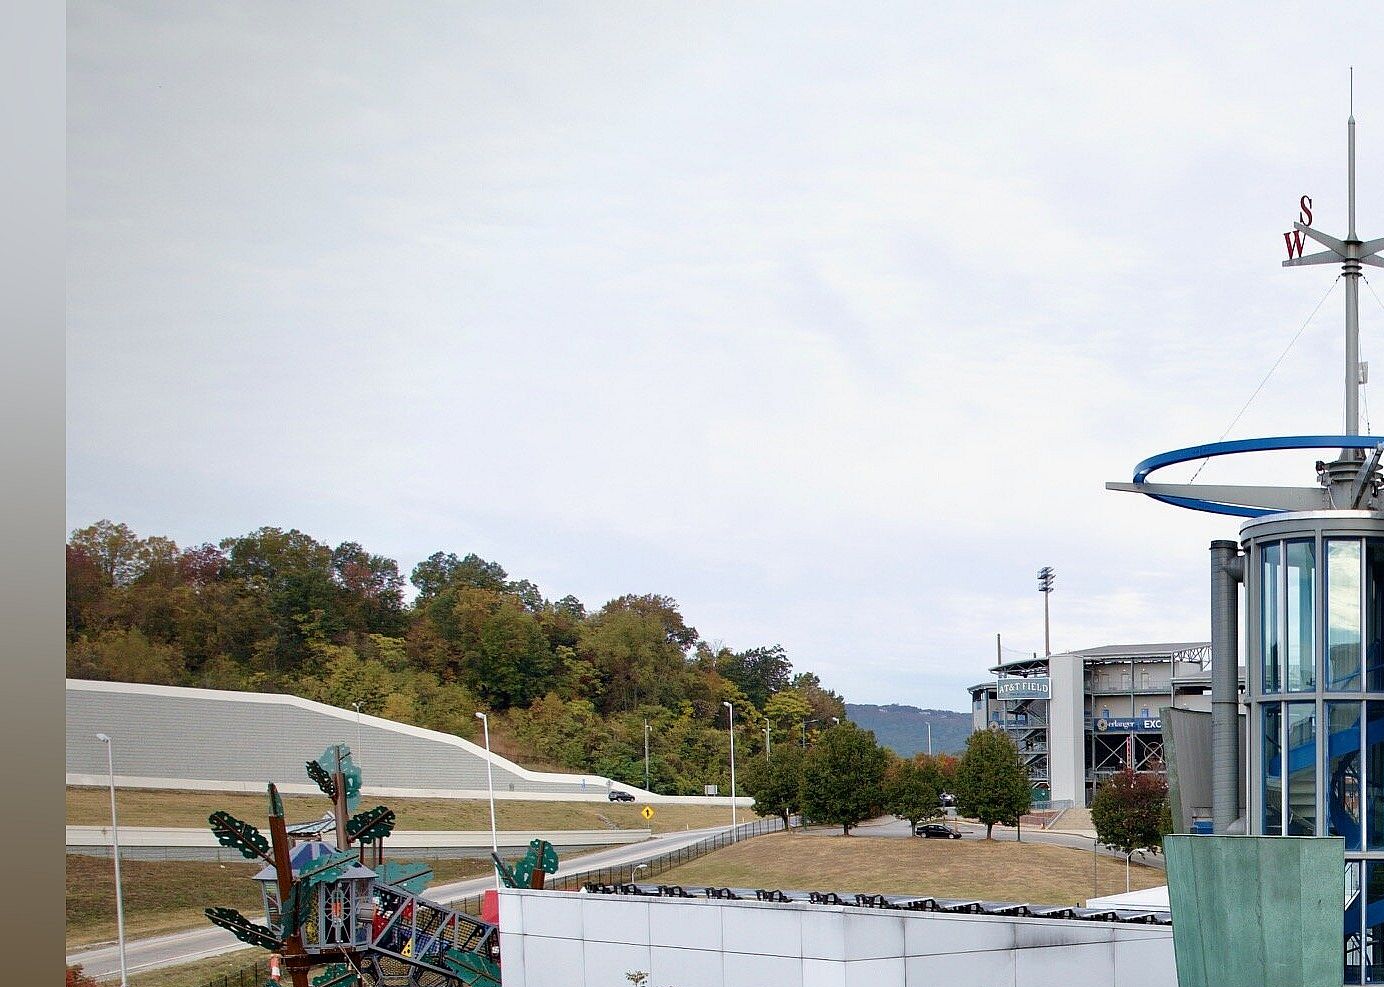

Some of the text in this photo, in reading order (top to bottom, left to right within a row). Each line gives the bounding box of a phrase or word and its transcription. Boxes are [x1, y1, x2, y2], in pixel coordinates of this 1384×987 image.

[1300, 195, 1313, 227] S
[1283, 230, 1307, 259] W
[999, 682, 1048, 693] AT&T FIELD
